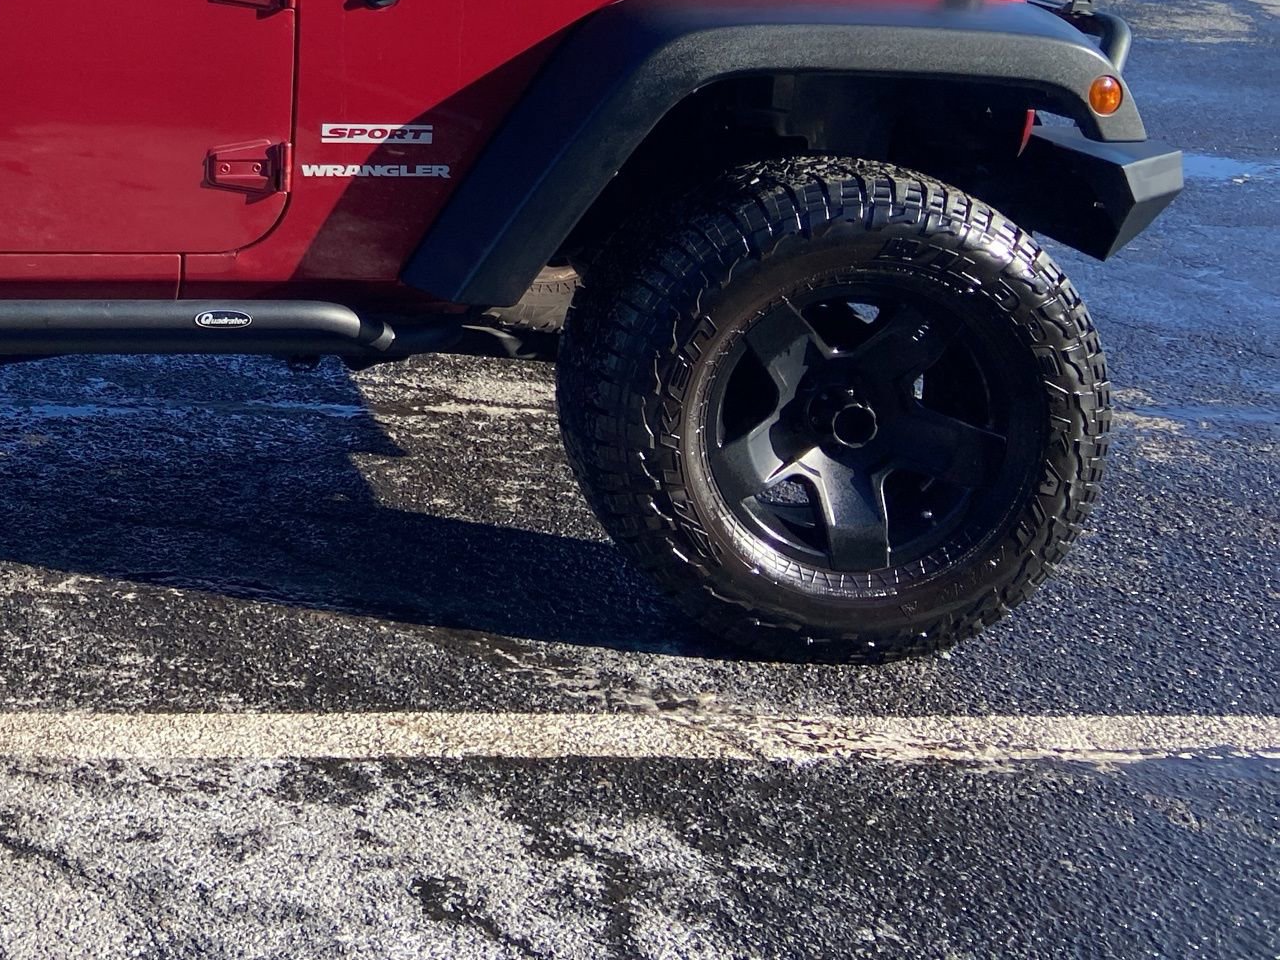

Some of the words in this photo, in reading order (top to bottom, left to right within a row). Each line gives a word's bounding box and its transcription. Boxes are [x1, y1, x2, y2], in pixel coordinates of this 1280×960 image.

[323, 126, 432, 141] SPORT
[302, 165, 450, 178] WRANGLER
[201, 313, 248, 325] Quadratec
